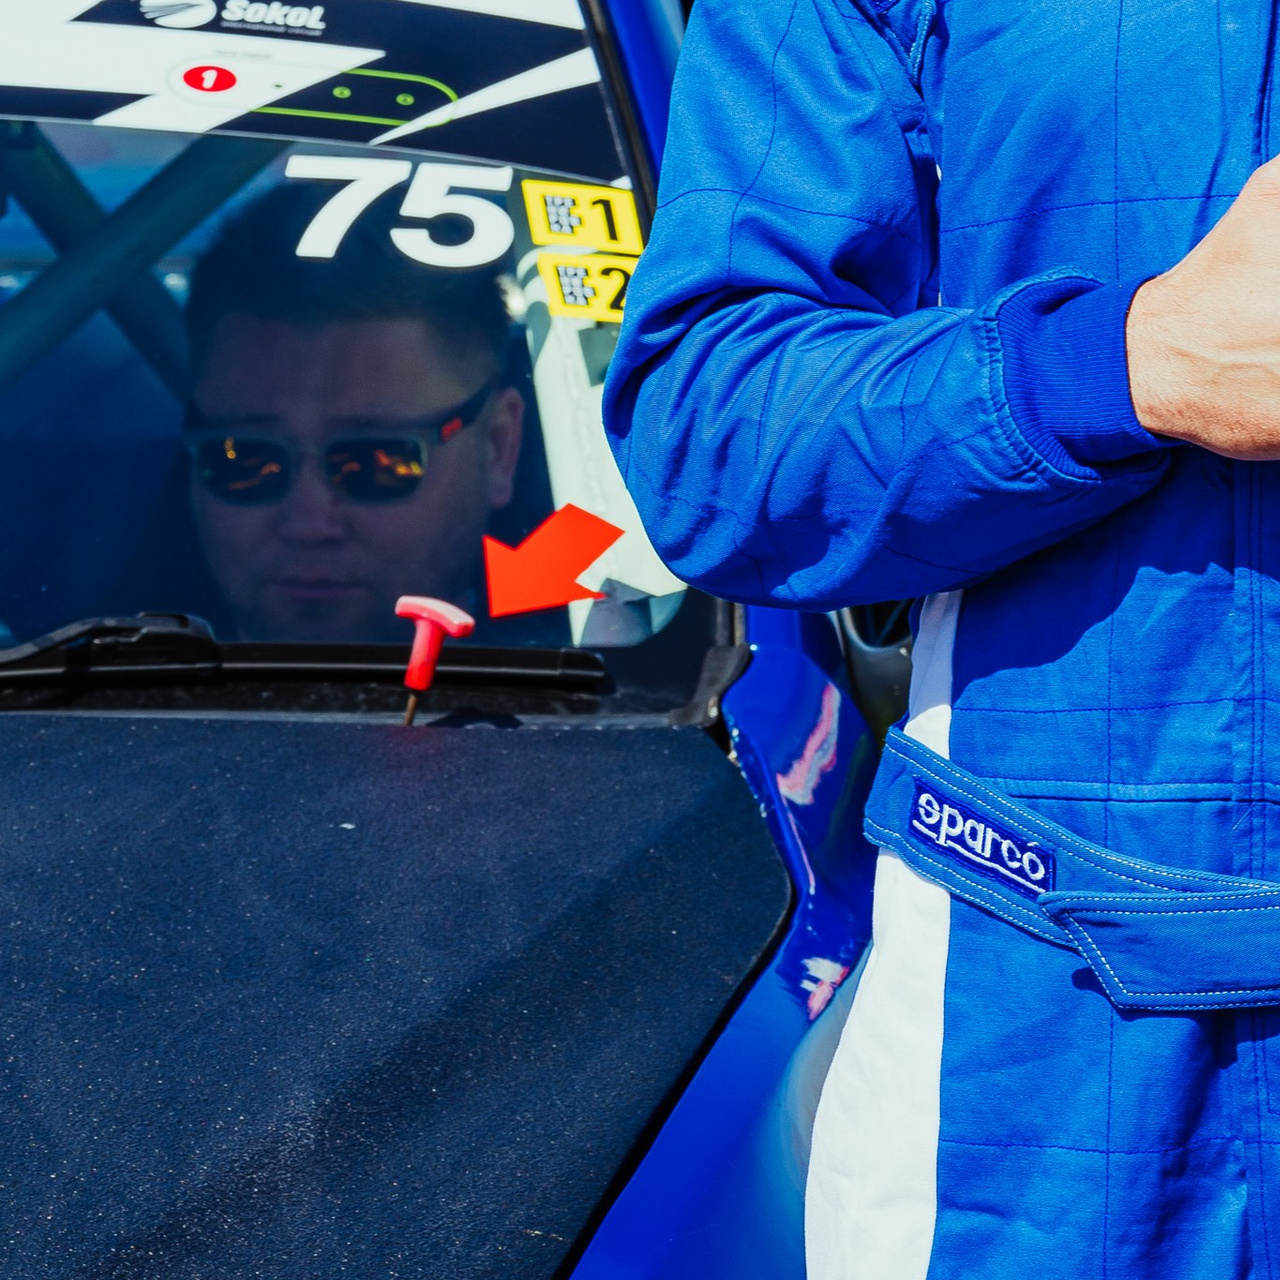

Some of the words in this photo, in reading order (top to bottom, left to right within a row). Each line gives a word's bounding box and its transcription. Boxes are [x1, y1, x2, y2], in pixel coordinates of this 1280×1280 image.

[284, 155, 515, 268] 75
[592, 199, 618, 241] 1
[600, 267, 632, 311] 2
[916, 791, 1046, 890] sparco
